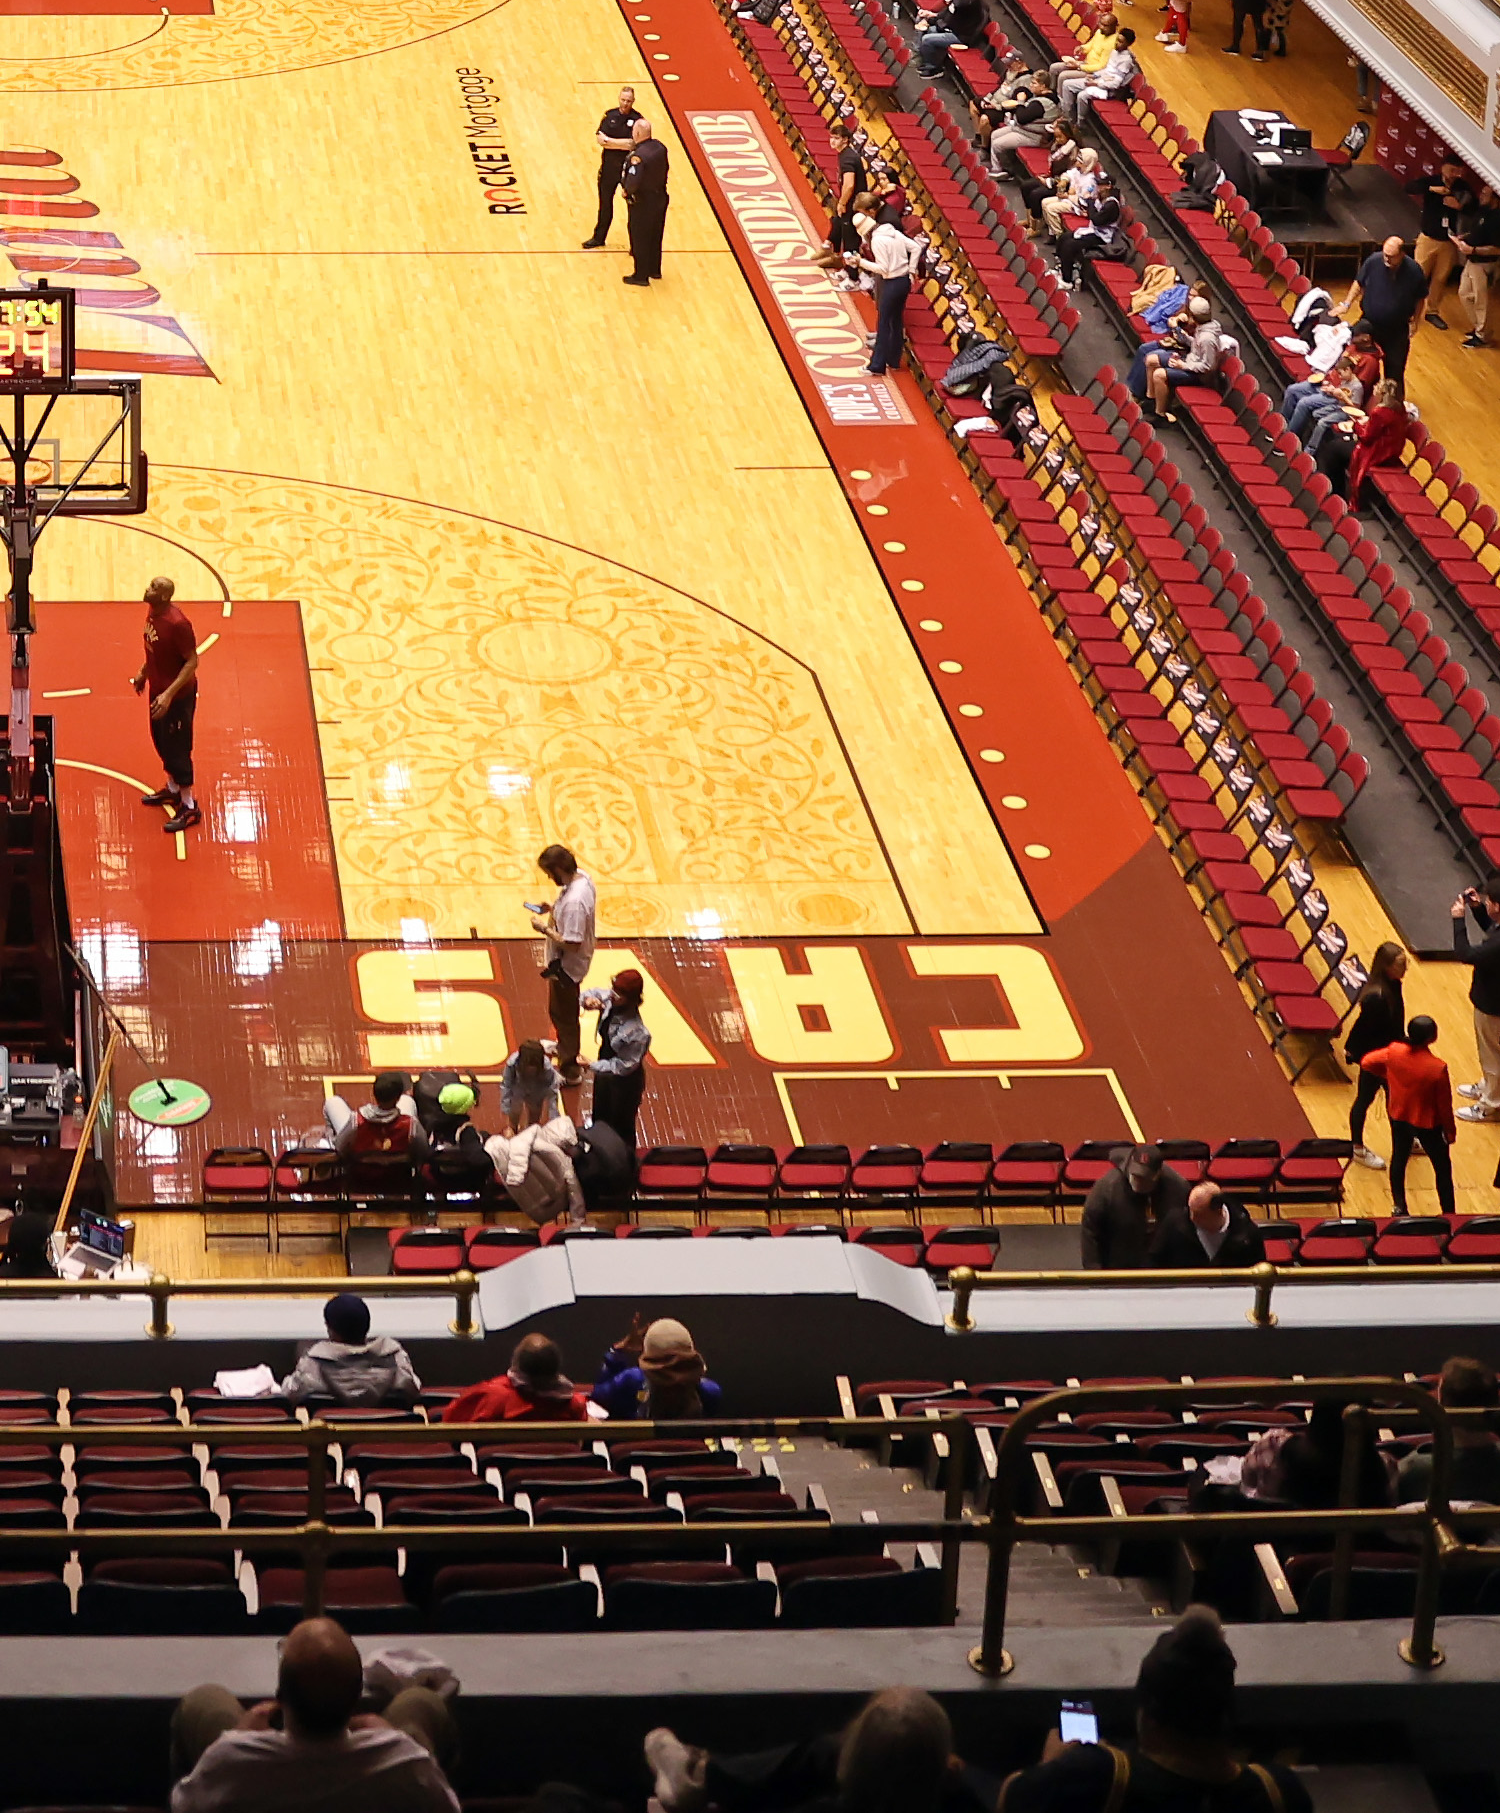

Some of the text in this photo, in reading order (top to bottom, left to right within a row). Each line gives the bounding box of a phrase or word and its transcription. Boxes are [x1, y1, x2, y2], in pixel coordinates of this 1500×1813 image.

[456, 67, 528, 216] ROCKET Mortgage
[692, 113, 872, 378] COURTSIDE CLUB
[818, 382, 882, 421] POPE'S
[871, 382, 901, 421] COCKTAILS
